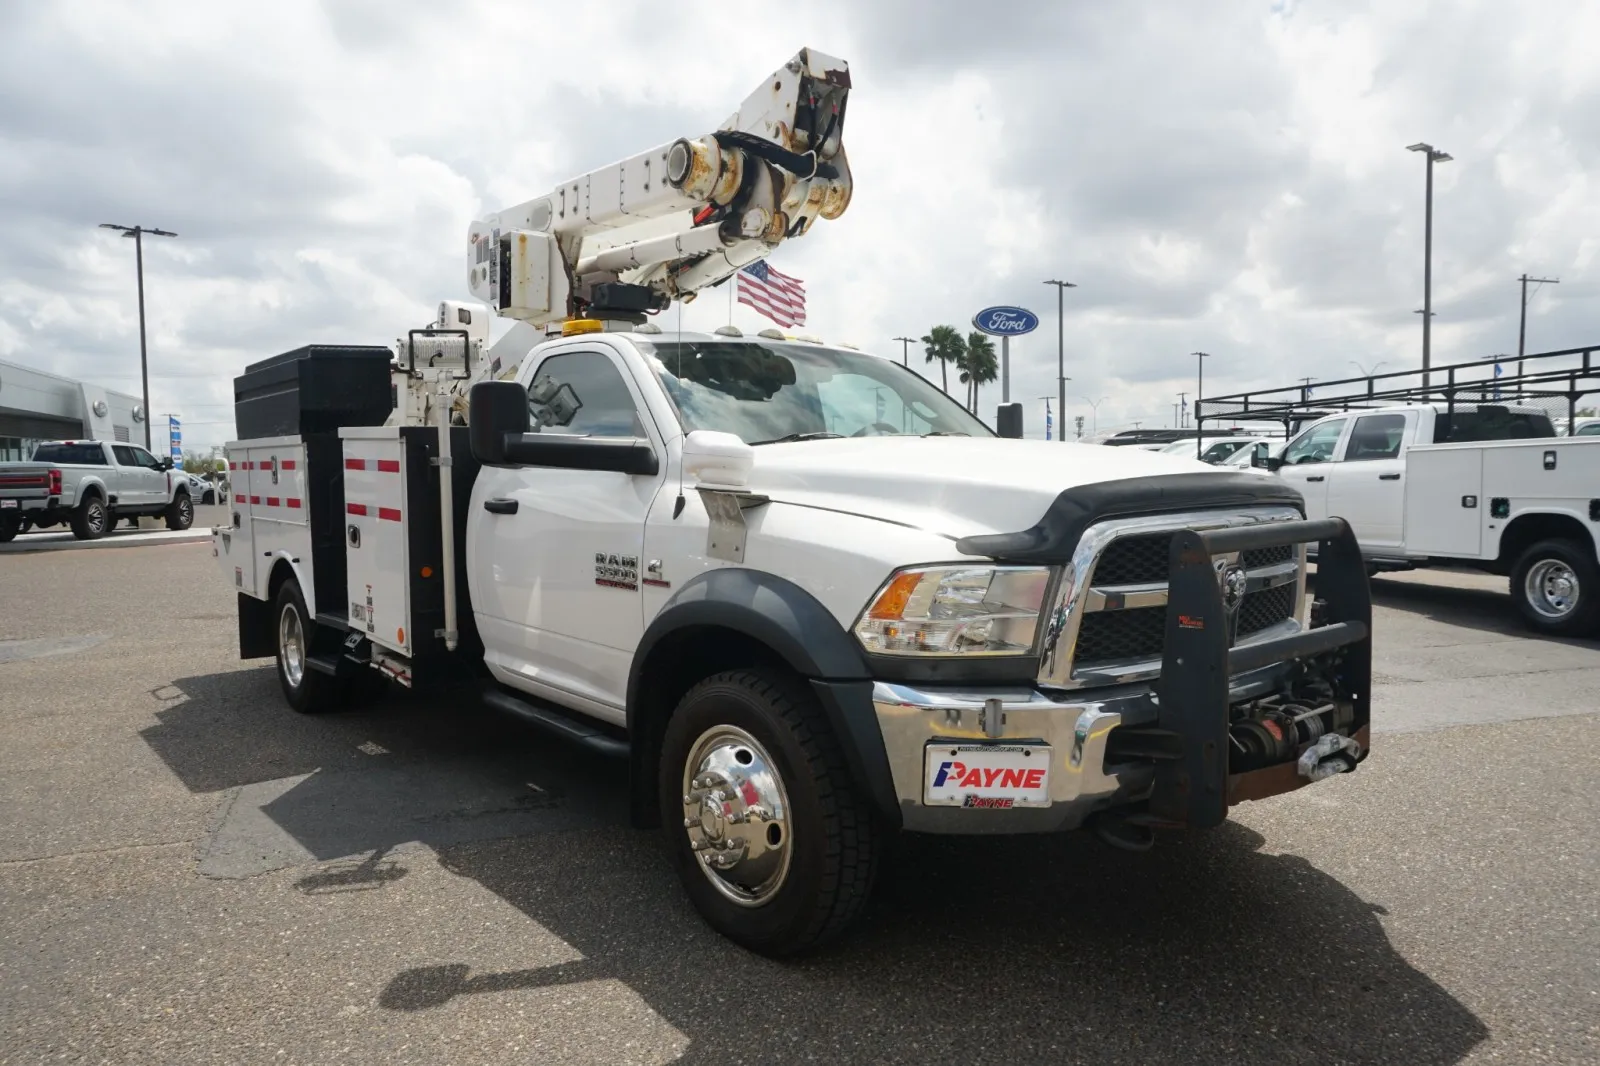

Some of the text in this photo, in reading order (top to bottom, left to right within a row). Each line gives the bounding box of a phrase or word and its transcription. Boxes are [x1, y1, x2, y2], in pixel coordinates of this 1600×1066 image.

[989, 311, 1027, 330] Ford
[595, 552, 638, 568] RAM
[595, 566, 637, 582] 5500
[933, 761, 1046, 788] PAYNE
[963, 794, 1014, 808] PAYNE
